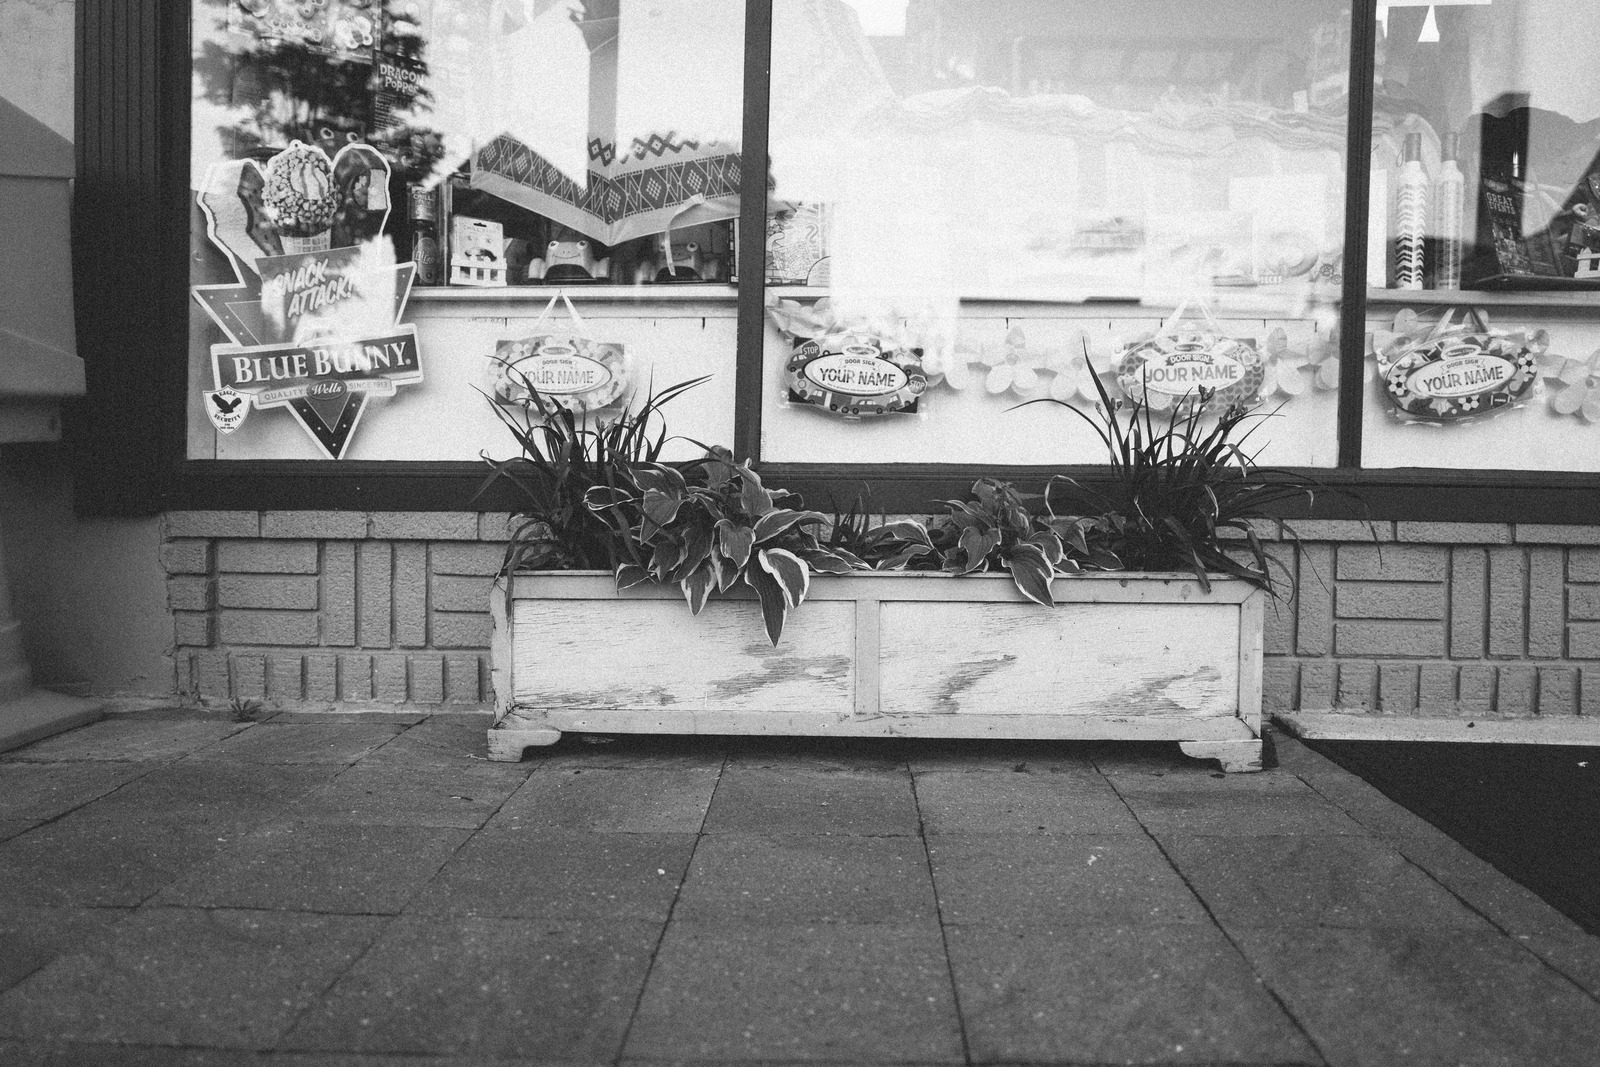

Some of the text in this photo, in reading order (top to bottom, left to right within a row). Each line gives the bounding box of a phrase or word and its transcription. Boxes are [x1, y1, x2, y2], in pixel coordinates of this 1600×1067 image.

[273, 258, 329, 296] SNACK
[287, 275, 353, 318] ATTACK!
[803, 346, 819, 355] STOP
[1169, 354, 1210, 362] DOOR SIGN
[1447, 361, 1464, 369] DOOR
[231, 354, 309, 384] BLUE
[1191, 364, 1238, 381] NAME
[558, 370, 594, 384] NAME
[820, 367, 855, 384] YOUR
[858, 371, 896, 387] NAME
[1423, 373, 1462, 392] YOUR
[1464, 365, 1504, 386] NAME
[311, 380, 342, 396] Wells
[350, 381, 370, 390] SINCE
[909, 380, 925, 389] STOP
[264, 388, 304, 401] QUALITY
[213, 413, 241, 423] SECURITY
